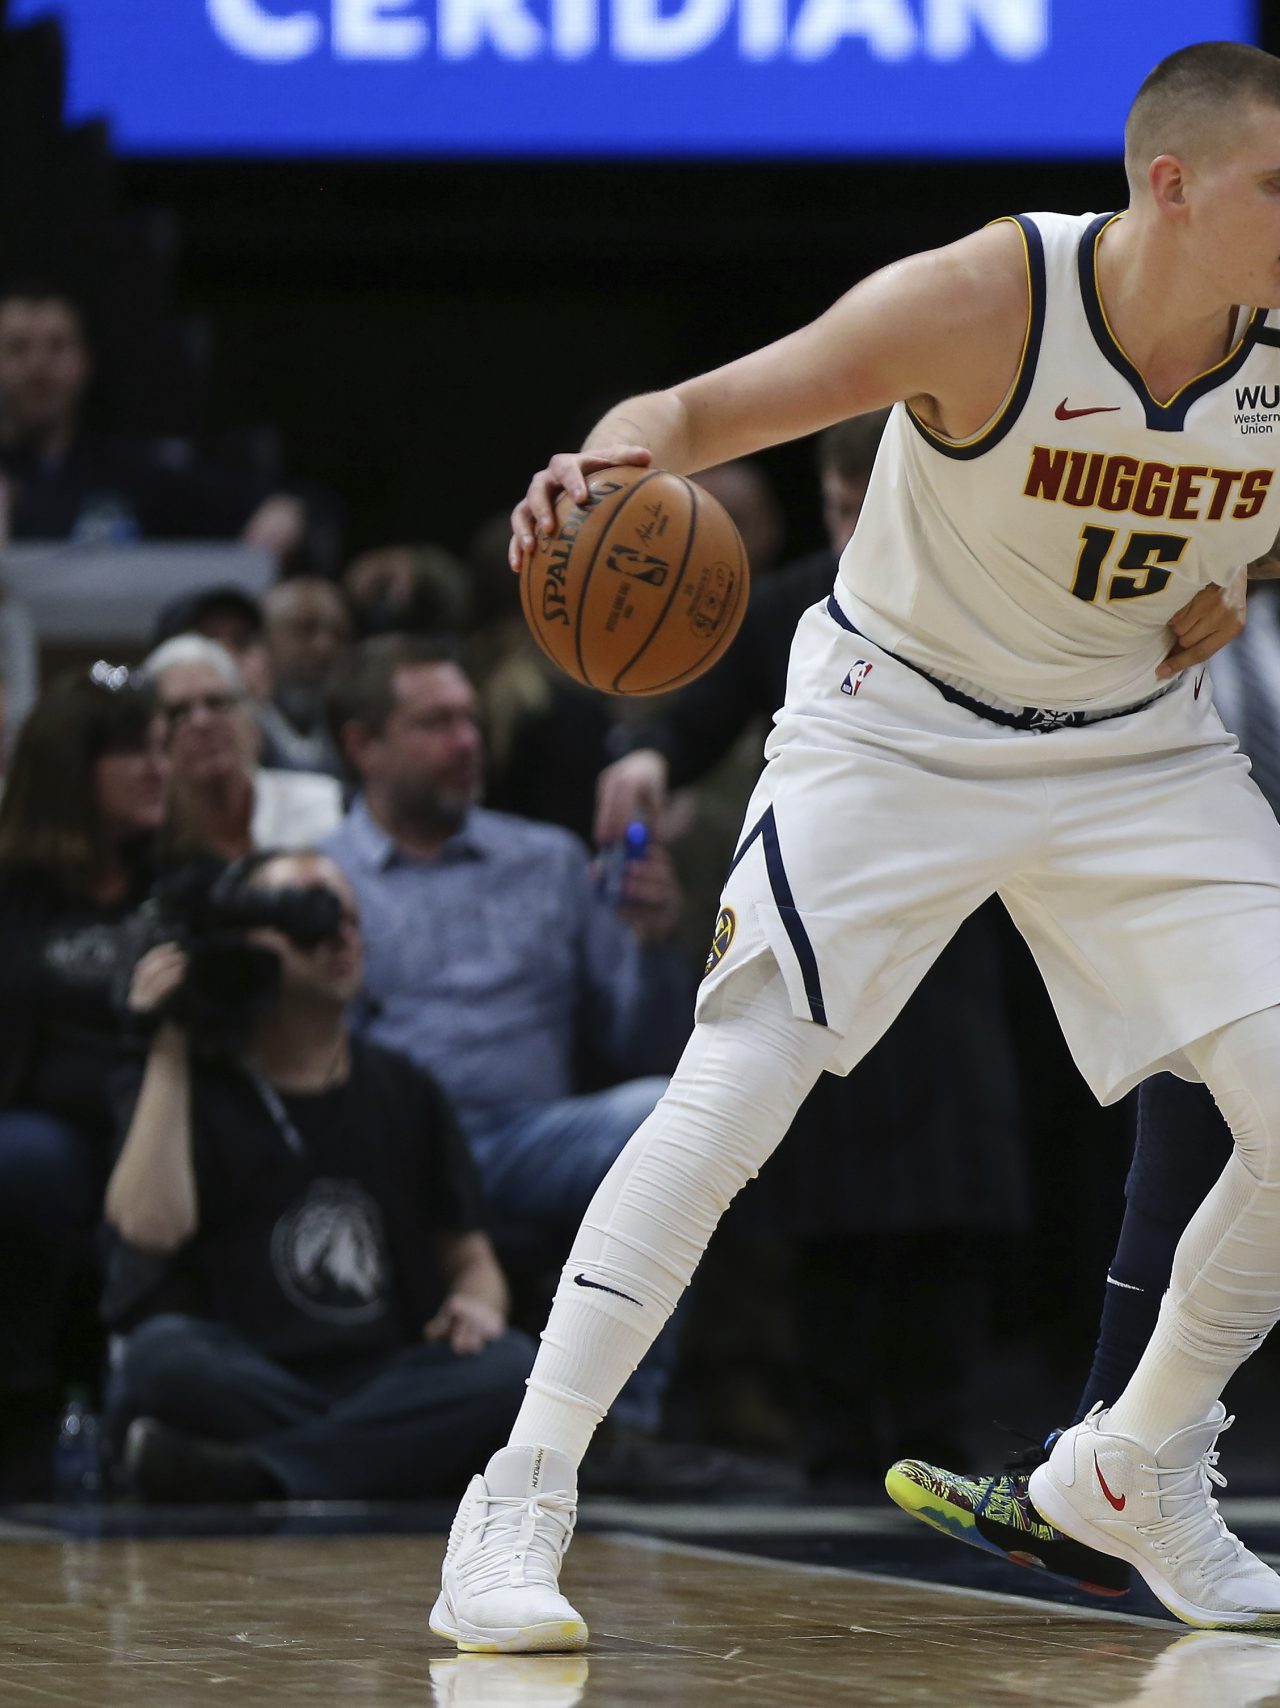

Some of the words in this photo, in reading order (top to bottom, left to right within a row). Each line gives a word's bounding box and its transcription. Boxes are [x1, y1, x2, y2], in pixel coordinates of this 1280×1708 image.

[1235, 385, 1280, 410] WU
[1233, 413, 1280, 424] Western
[1240, 423, 1273, 434] Union
[1019, 444, 1276, 521] NUGGETS
[1068, 522, 1192, 605] 15
